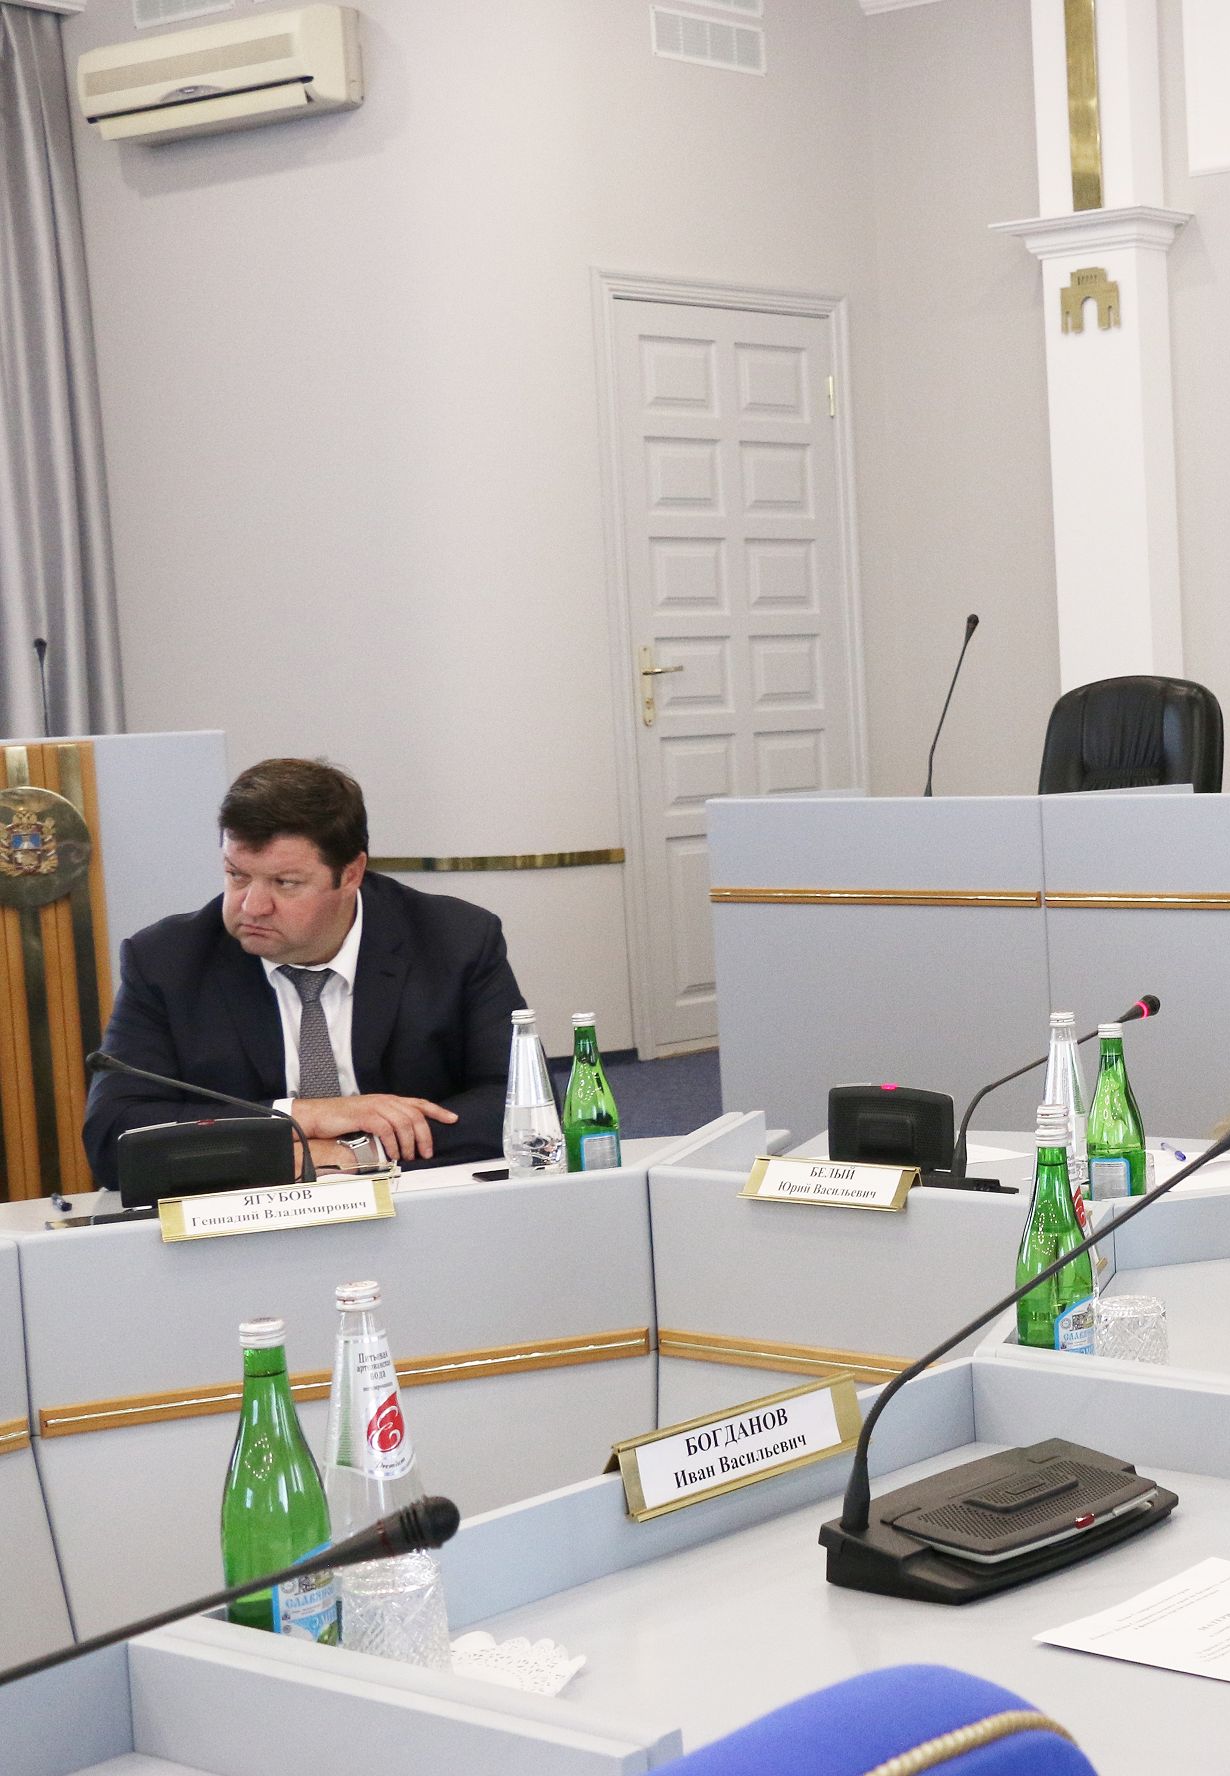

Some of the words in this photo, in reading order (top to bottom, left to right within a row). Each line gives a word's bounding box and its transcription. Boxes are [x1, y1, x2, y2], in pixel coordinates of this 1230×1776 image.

[809, 1165, 856, 1180] БЕЛЫЙ
[243, 1189, 313, 1207] ЯГУБОВ
[777, 1180, 811, 1194] Юрий
[812, 1183, 877, 1199] Васильевич
[191, 1210, 260, 1227] Геннадий
[264, 1200, 367, 1220] Владимирович
[685, 1407, 788, 1456] БОГДАНОВ
[673, 1468, 716, 1489] Иван
[718, 1434, 807, 1473] Васильевич
